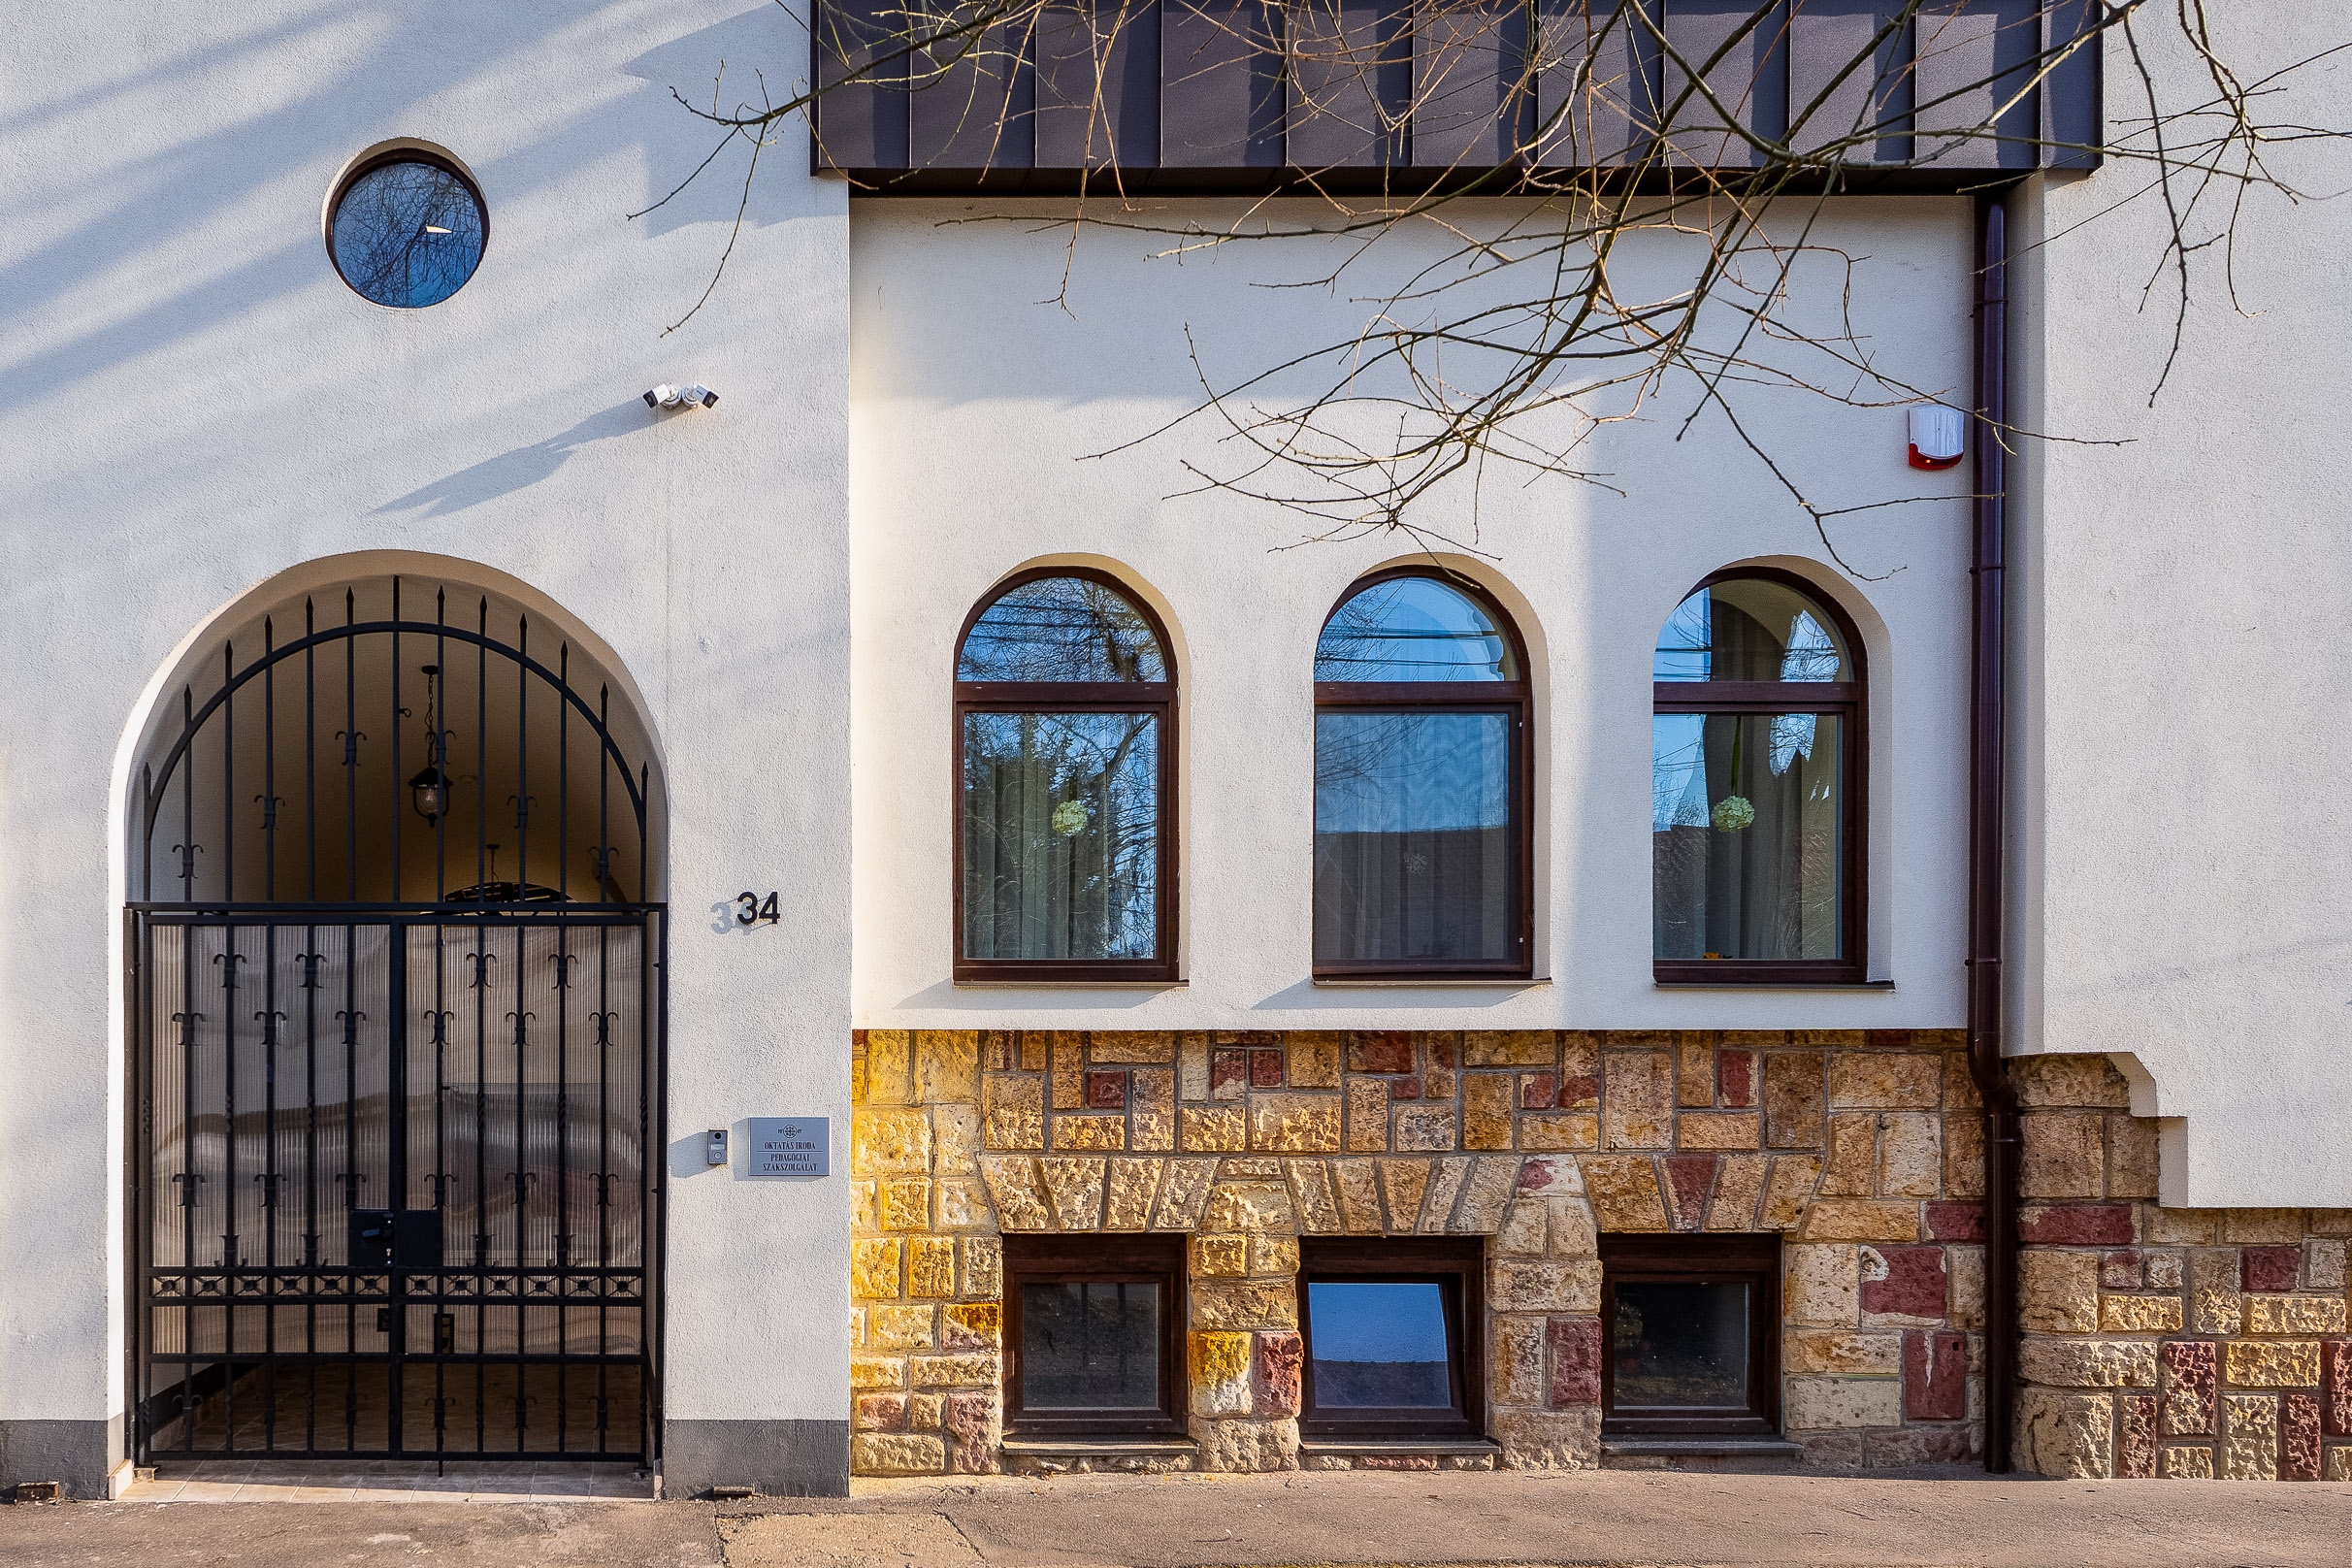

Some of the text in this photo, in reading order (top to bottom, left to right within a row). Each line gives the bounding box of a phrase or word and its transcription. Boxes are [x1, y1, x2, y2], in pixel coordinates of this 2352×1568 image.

[737, 891, 780, 925] 34
[764, 1141, 816, 1150] OKTATÁS IRODA
[770, 1153, 810, 1161] PEDAGÓGIAI
[763, 1162, 818, 1171] SZAKSZOLGÁLAT
